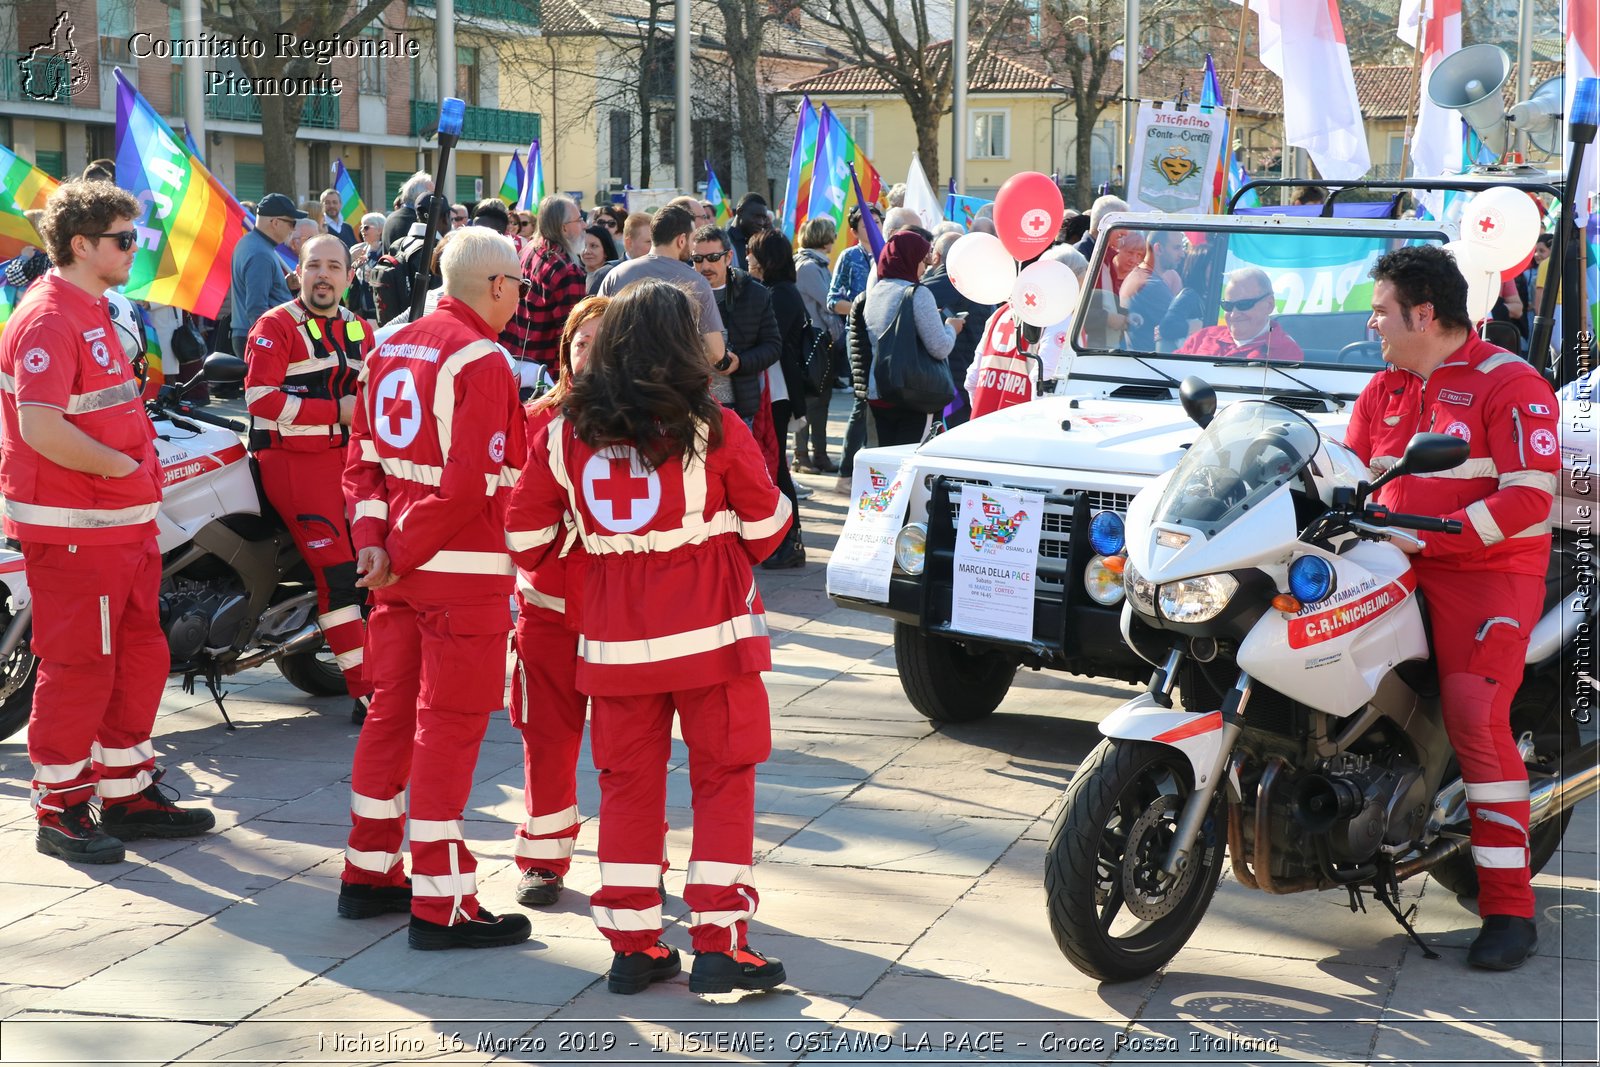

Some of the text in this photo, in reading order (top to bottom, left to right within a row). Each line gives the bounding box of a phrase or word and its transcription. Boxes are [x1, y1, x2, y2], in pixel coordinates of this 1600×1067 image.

[170, 451, 188, 463] ITALIA
[879, 535, 895, 546] PACE
[1005, 545, 1025, 553] OSIAMO
[958, 563, 987, 576] MARCIA
[987, 567, 1011, 579] DELLA
[1011, 570, 1031, 582] PACE
[994, 587, 1015, 595] CORTEO
[1332, 585, 1361, 604] YAMAHA
[1360, 578, 1377, 593] ITALIA
